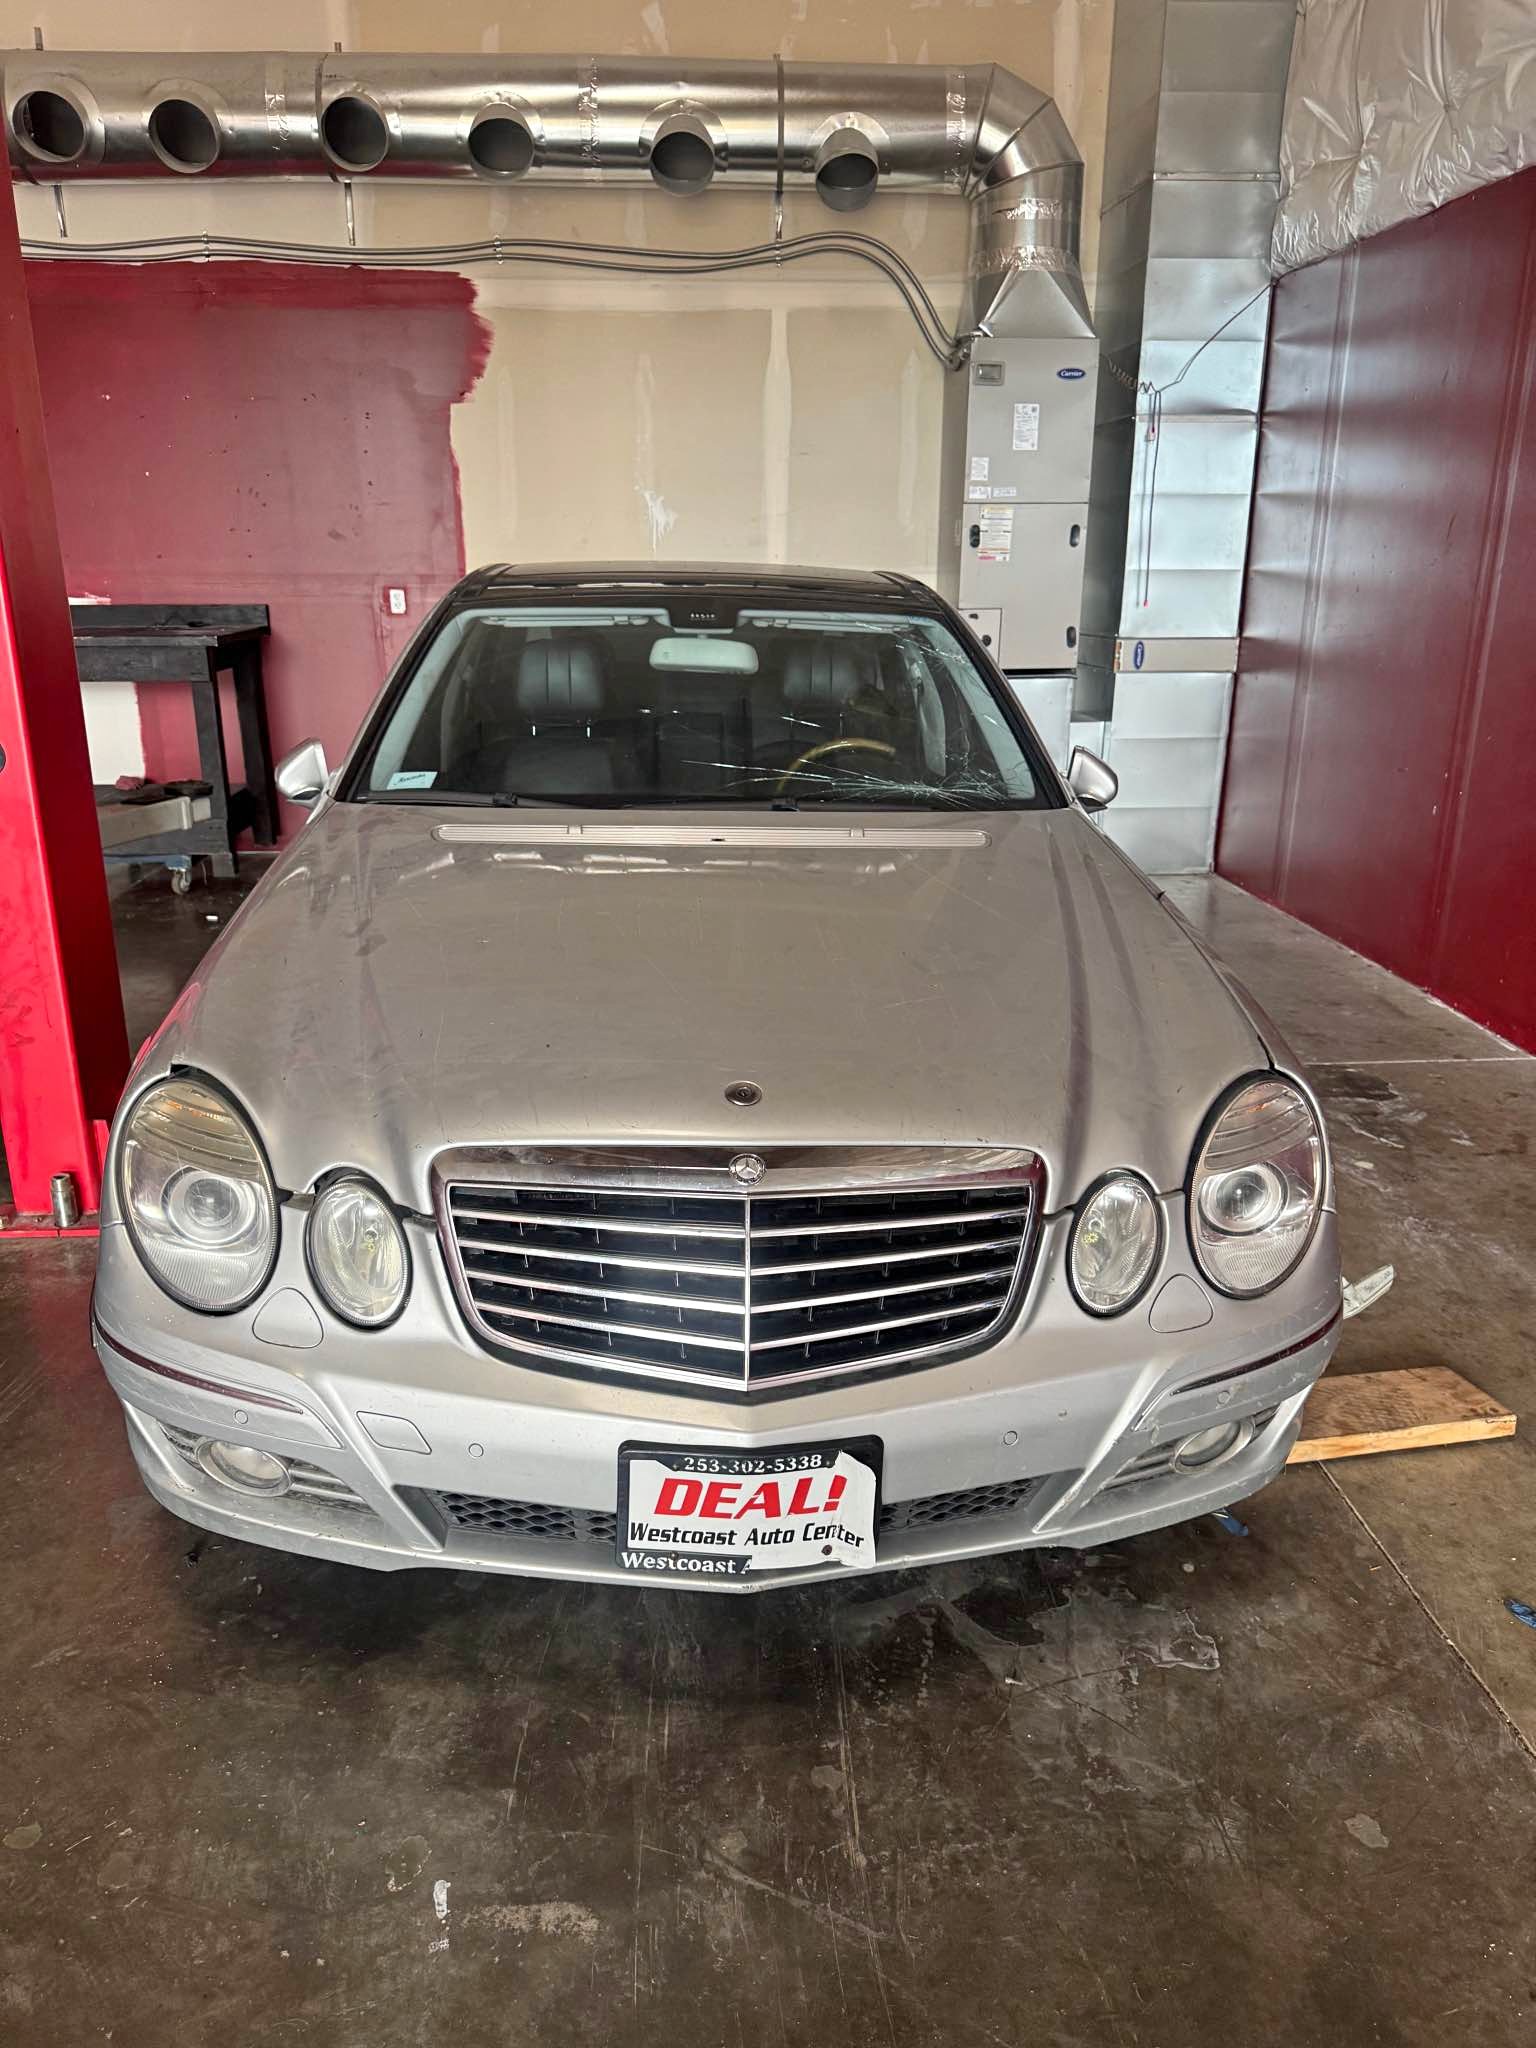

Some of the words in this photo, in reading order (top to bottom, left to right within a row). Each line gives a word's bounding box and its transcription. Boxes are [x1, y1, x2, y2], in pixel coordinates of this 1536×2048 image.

[684, 1454, 822, 1474] 253-302-5338
[654, 1475, 848, 1520] DEAL!
[630, 1521, 737, 1546] Westcoast
[744, 1527, 795, 1546] Auto
[802, 1522, 864, 1548] Center
[621, 1552, 736, 1574] Westcoast
